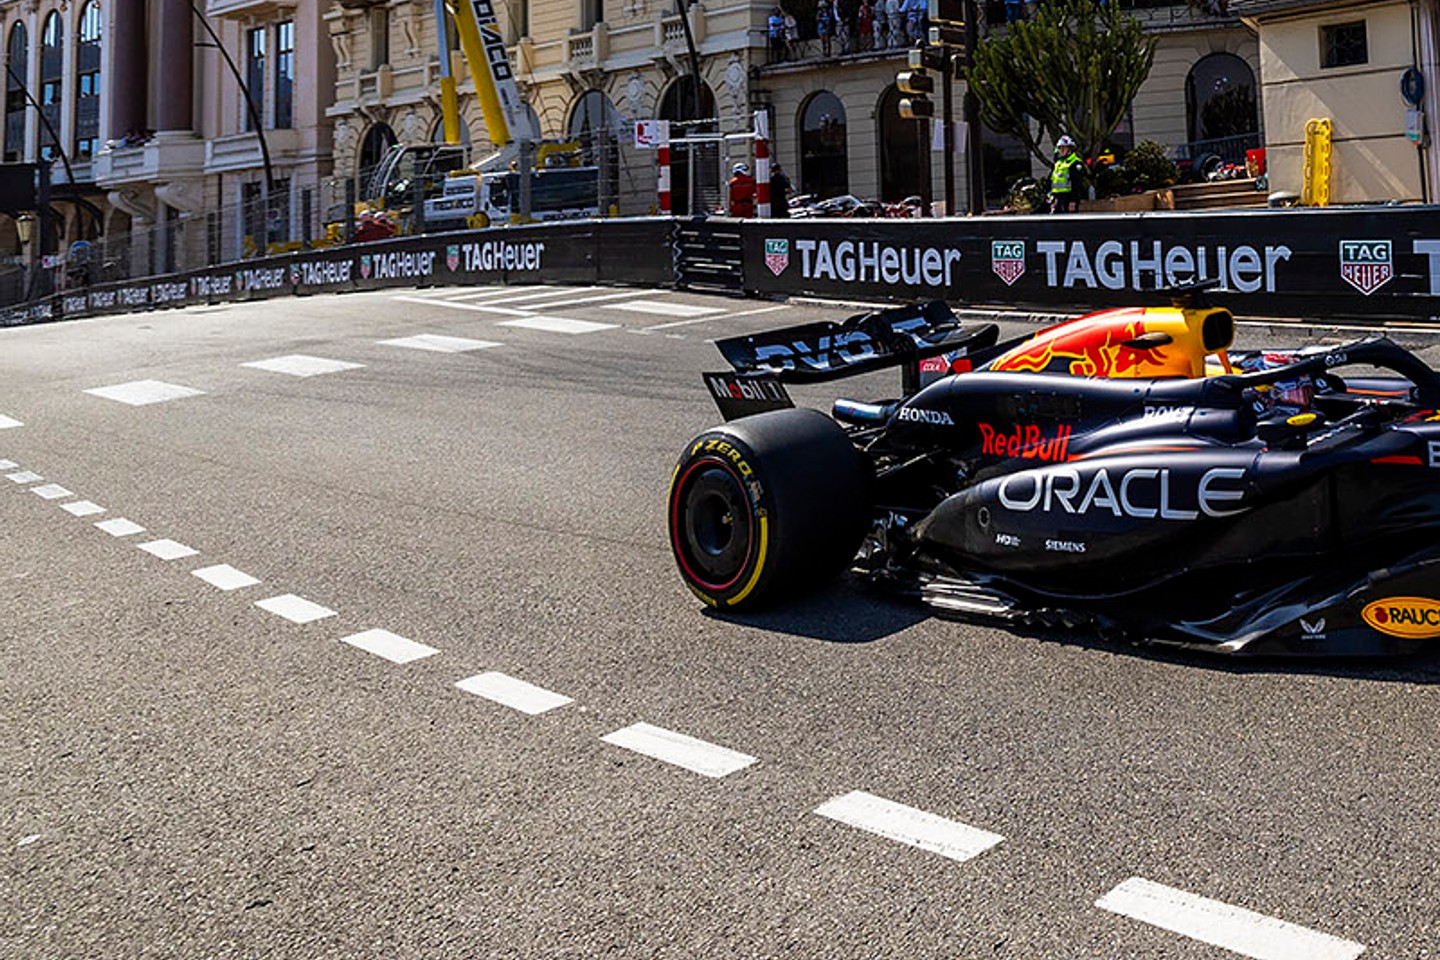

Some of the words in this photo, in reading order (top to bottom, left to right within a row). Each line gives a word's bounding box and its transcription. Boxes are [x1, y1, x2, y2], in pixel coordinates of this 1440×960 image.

[995, 245, 1022, 258] TAG
[1344, 245, 1388, 260] TAG
[710, 377, 765, 401] Mobil
[898, 407, 955, 426] HONDA
[704, 439, 754, 476] ZERO
[998, 468, 1252, 520] ORACLE
[1045, 539, 1087, 553] SIEMENS
